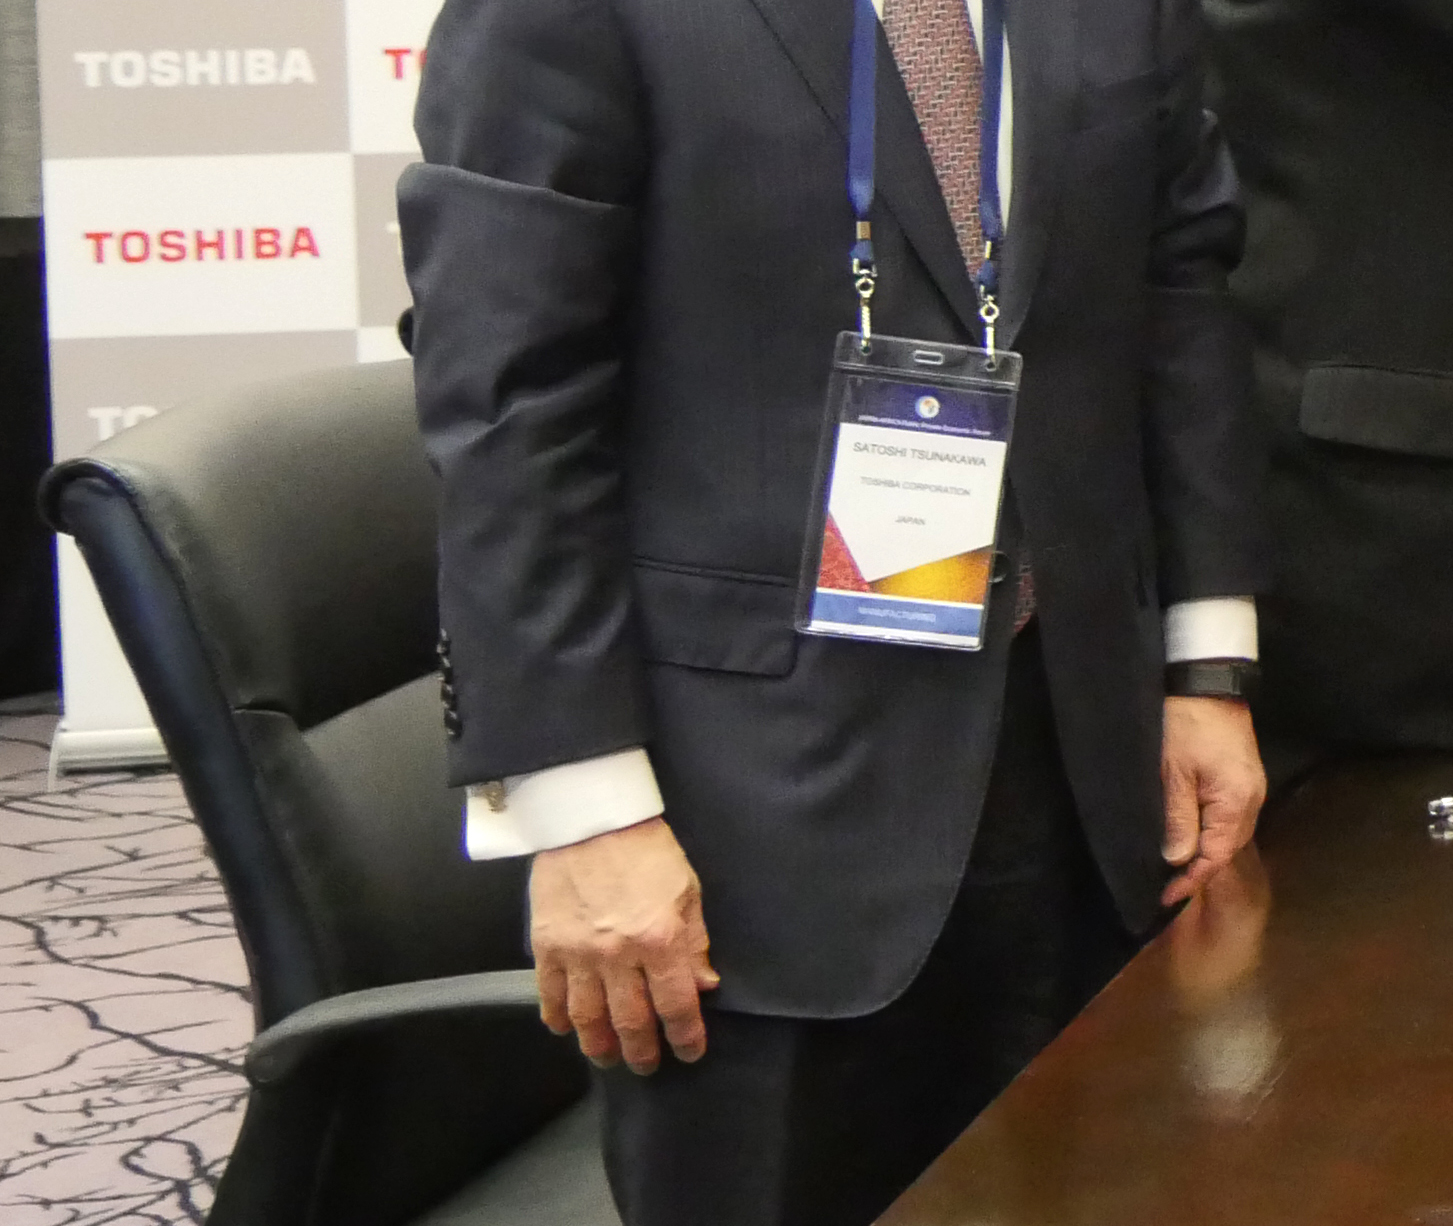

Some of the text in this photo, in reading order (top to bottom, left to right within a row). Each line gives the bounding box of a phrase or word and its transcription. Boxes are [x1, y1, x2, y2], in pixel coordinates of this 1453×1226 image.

[75, 49, 315, 88] TOSHIBA
[383, 46, 428, 80] T
[84, 226, 320, 264] TOSHIBA
[853, 441, 986, 466] SATOSHI TSUNAKAWA
